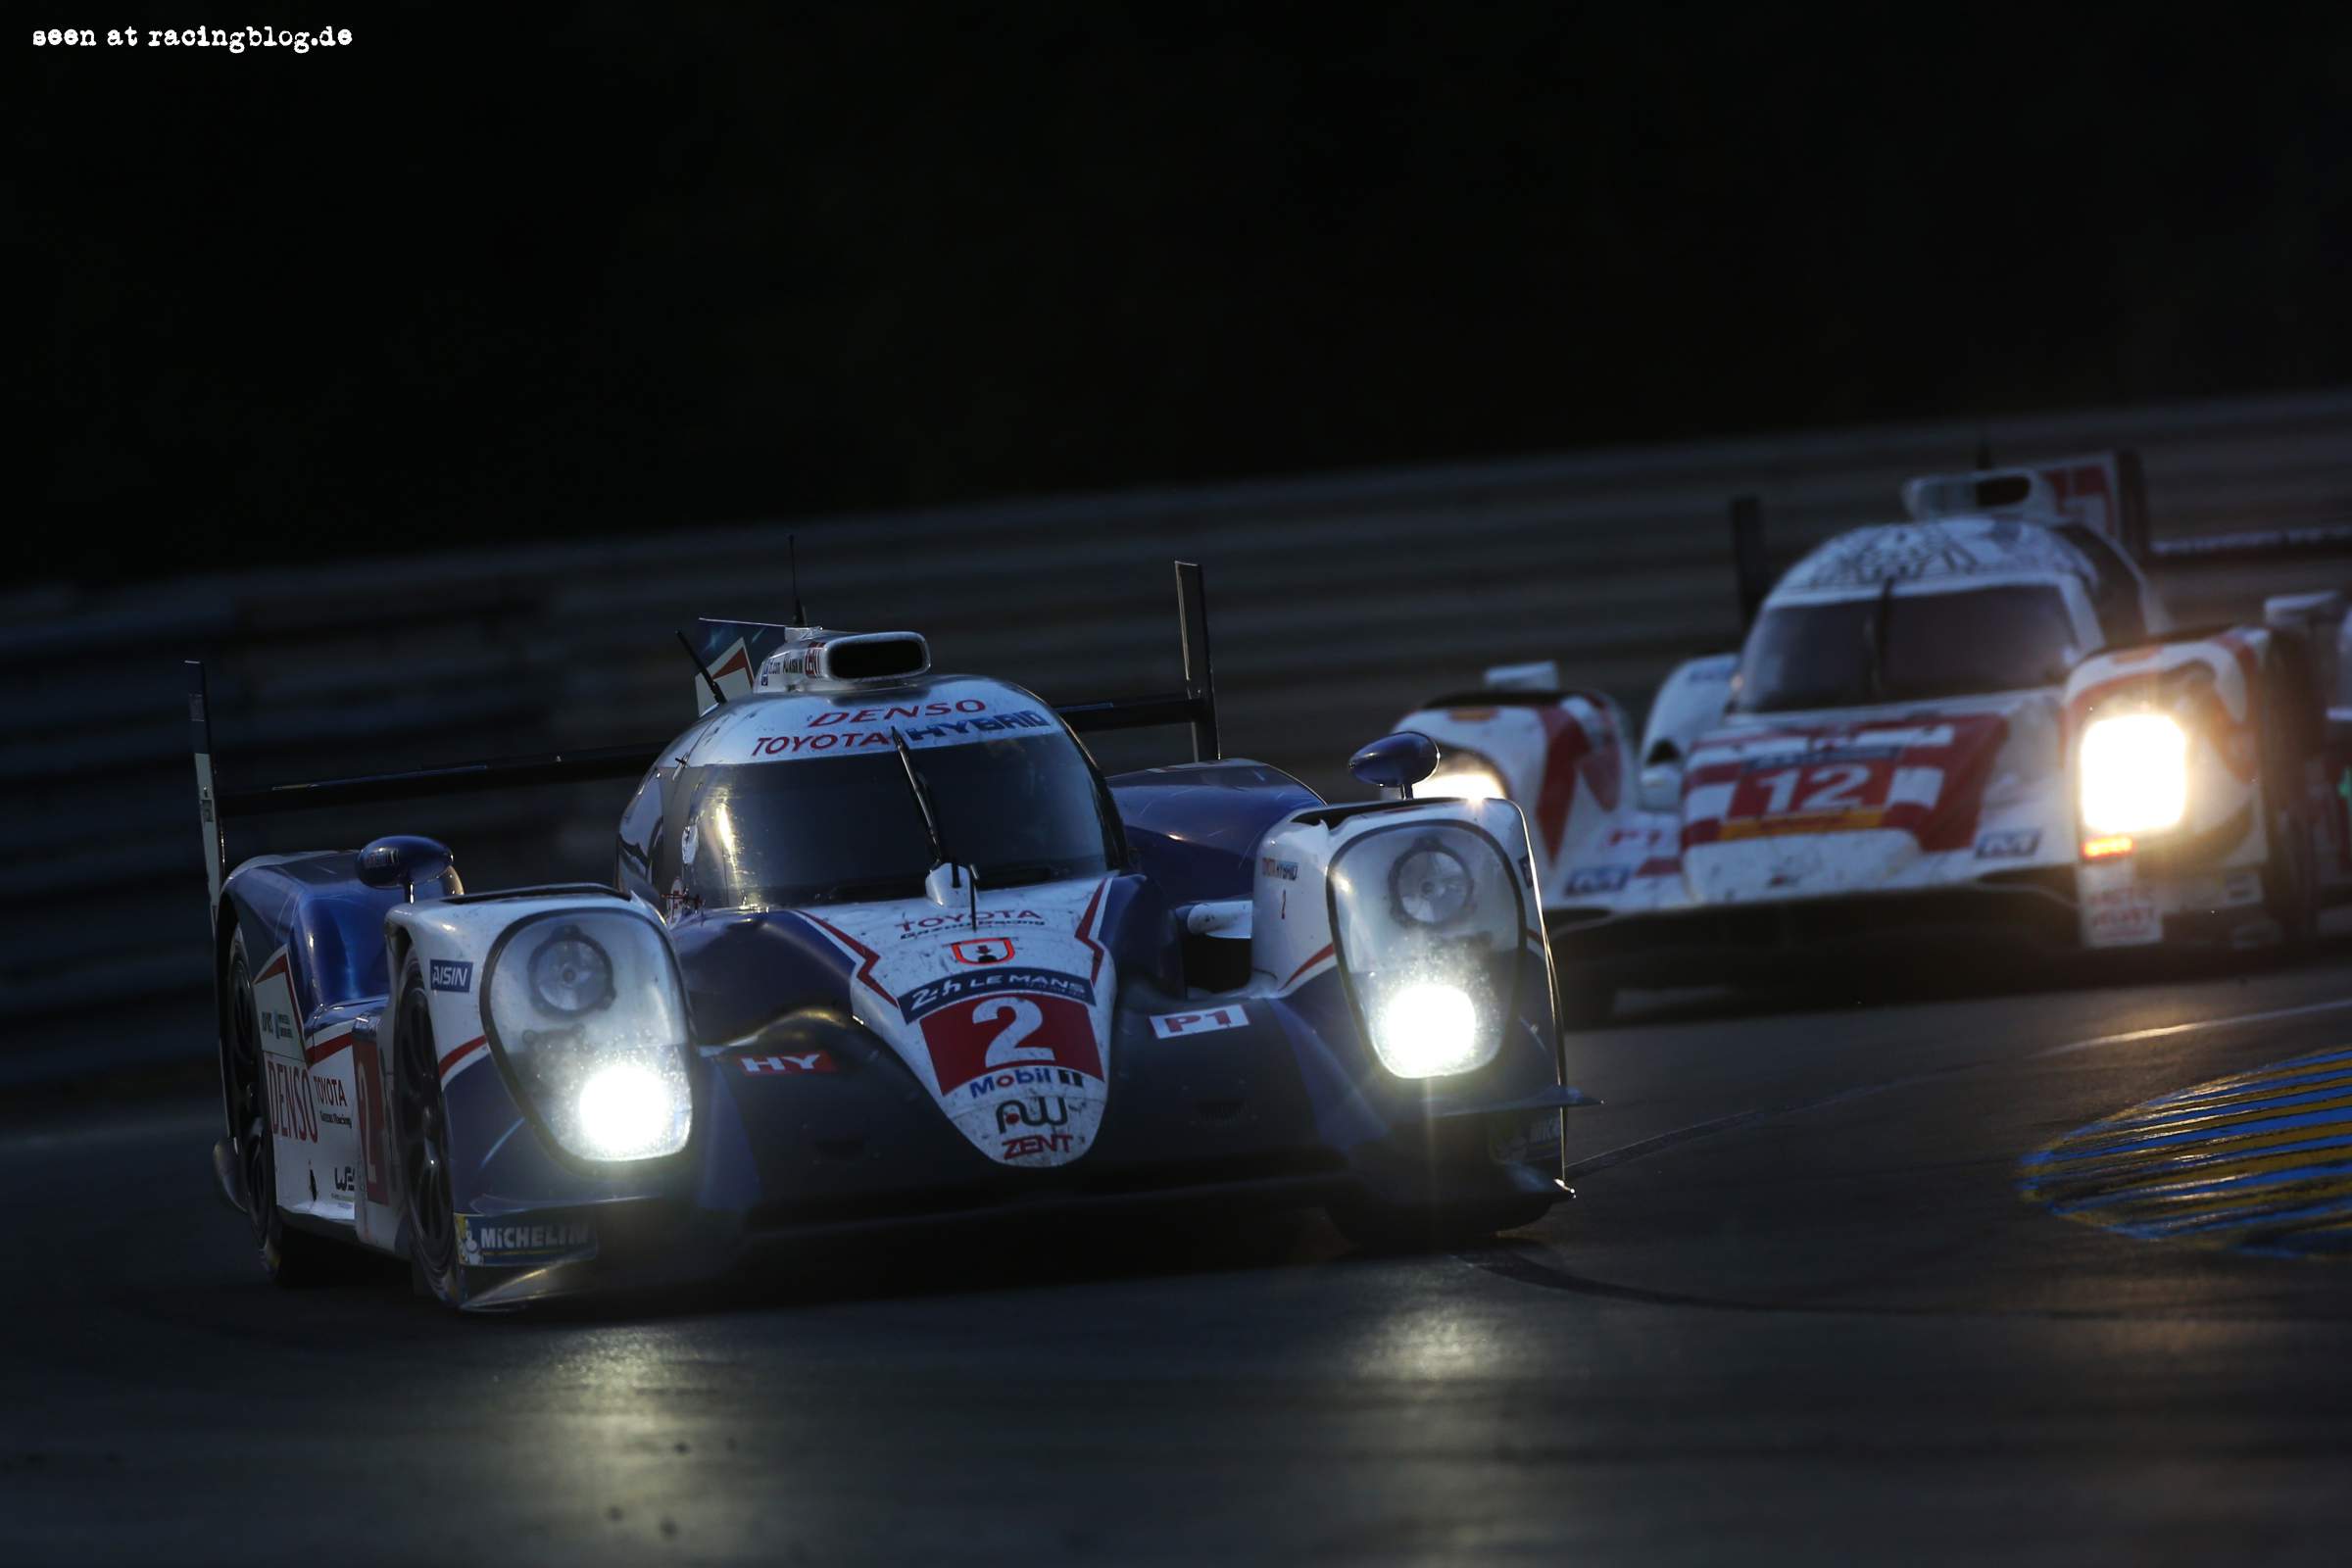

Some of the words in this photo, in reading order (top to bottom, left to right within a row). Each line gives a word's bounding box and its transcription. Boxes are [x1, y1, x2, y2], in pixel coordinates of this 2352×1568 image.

[808, 700, 986, 728] DENSO
[752, 731, 892, 757] TOYOTA
[906, 710, 1052, 742] HYBRID
[1756, 763, 1872, 812] 12
[894, 909, 1043, 932] TOYOTA
[431, 965, 467, 988] AISIN
[970, 978, 1003, 988] LE
[1007, 974, 1087, 995] MANS
[971, 997, 1056, 1069] 2
[1163, 1010, 1232, 1034] P1
[741, 1054, 821, 1073] HY
[313, 1076, 348, 1107] TOYOTA
[970, 1068, 1052, 1099] Mobil
[268, 1061, 318, 1144] DENSO
[1003, 1134, 1073, 1160] ZENT
